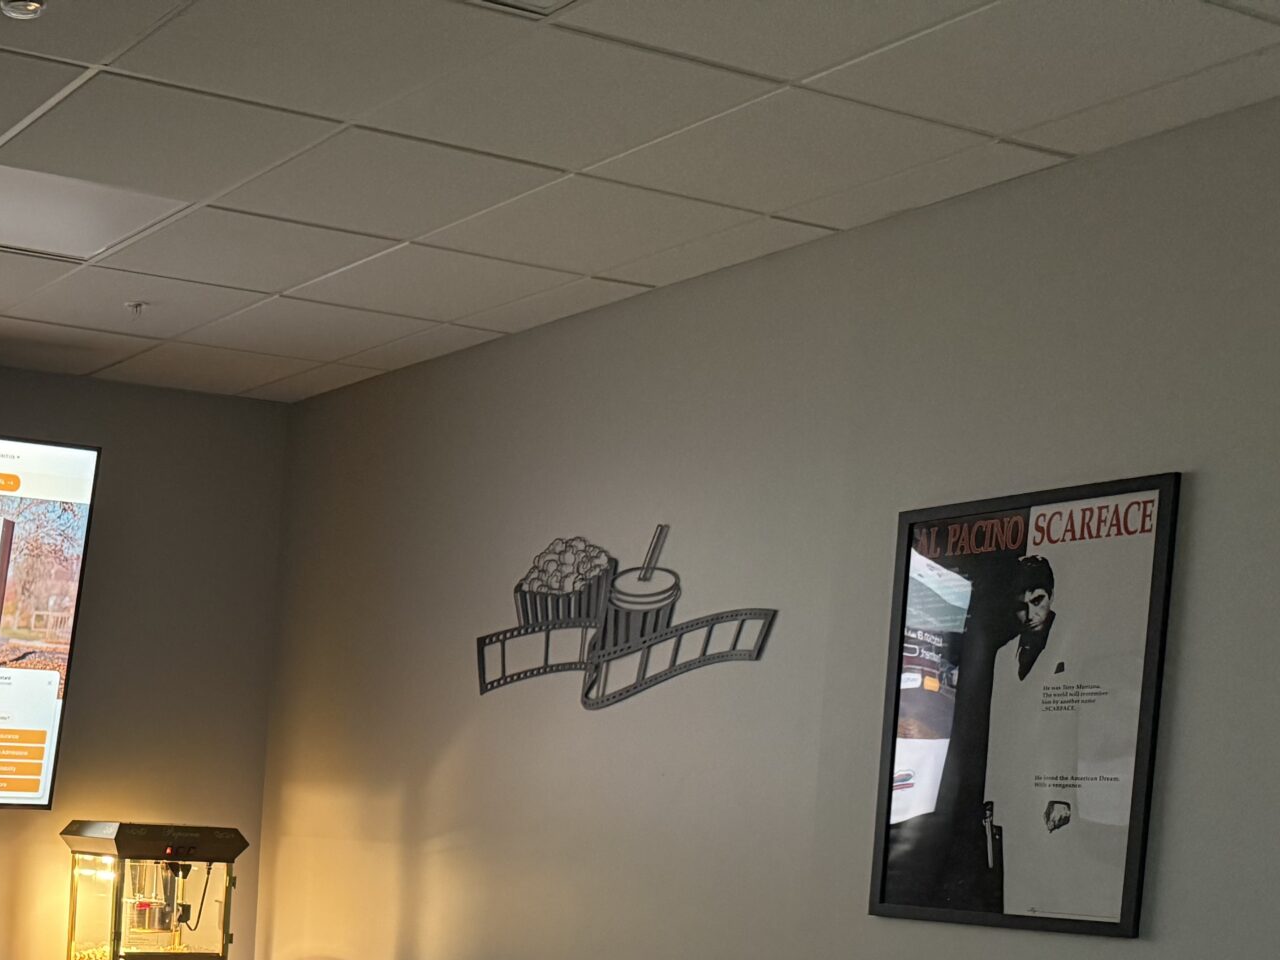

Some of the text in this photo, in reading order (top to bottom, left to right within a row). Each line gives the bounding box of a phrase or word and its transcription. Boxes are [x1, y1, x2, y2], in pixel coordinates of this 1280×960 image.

[914, 514, 1025, 559] AL PACINO
[1032, 499, 1155, 546] SCARFACE
